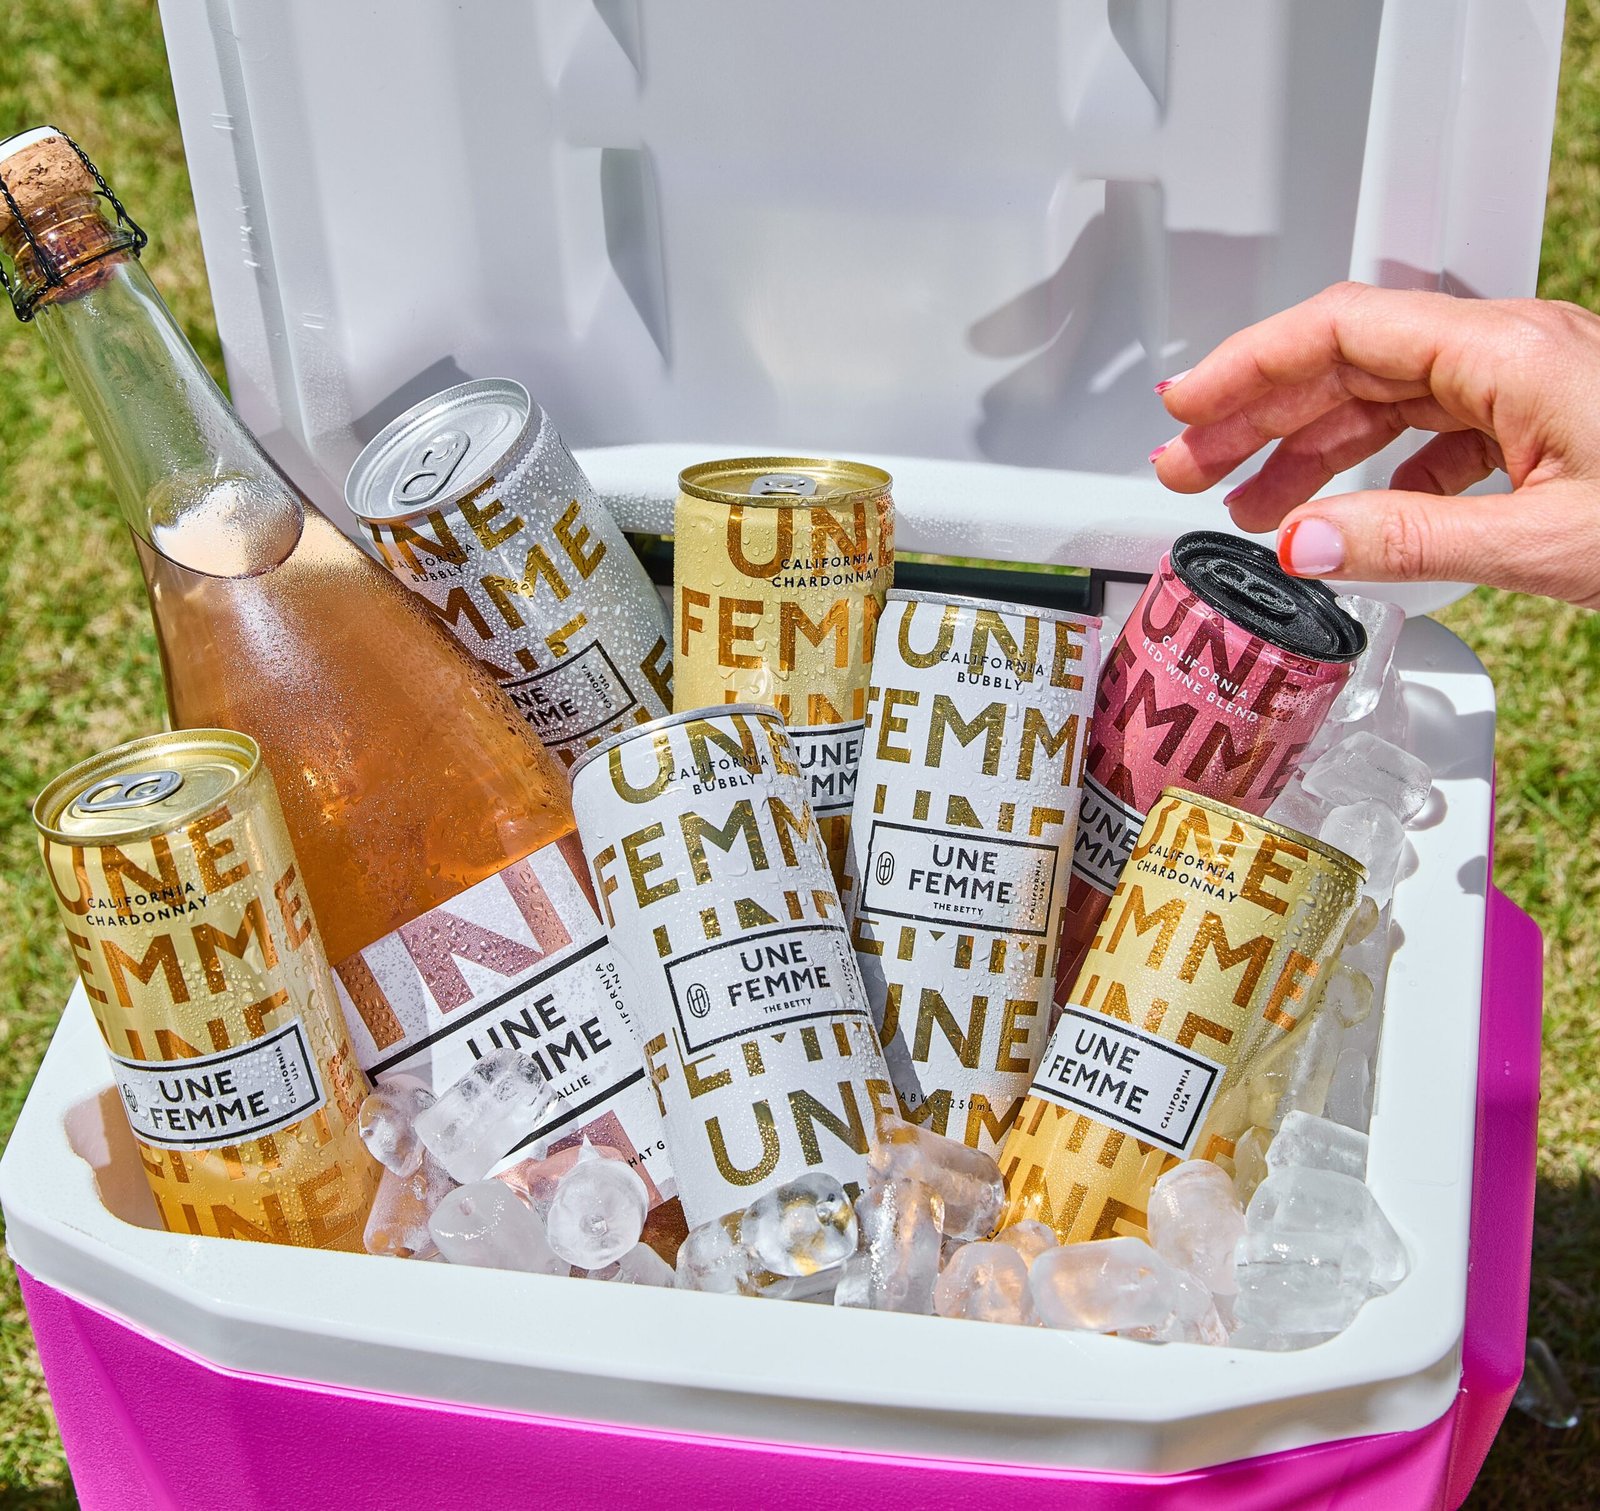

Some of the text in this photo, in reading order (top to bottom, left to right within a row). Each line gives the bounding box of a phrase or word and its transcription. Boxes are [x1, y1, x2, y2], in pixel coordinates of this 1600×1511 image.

[389, 543, 475, 570] CALIFORNIA
[411, 500, 607, 641] MME
[411, 563, 464, 583] BUBBLY
[780, 552, 874, 571] CALIFORNIA
[772, 568, 879, 589] CHARDONNAY
[681, 585, 881, 672] FEM
[898, 602, 1087, 691] UNE
[1141, 572, 1319, 724] UNE
[939, 650, 1045, 677] CALIFORNIA
[957, 671, 1024, 692] BUBBLY
[1142, 637, 1259, 724] RED WINE BLEND
[1162, 635, 1249, 701] CALIFORNIA
[509, 687, 549, 709] NE
[1094, 634, 1311, 800] EMME
[796, 739, 859, 770] UNE
[865, 687, 1094, 789] EMM
[607, 712, 798, 805] UNE
[667, 756, 769, 783] CALIFORNIA
[692, 773, 756, 795] BUBBLY
[1079, 796, 1139, 854] UNE
[42, 806, 250, 917] UNE
[593, 797, 827, 930] FEMM
[932, 844, 999, 876] UNE
[1132, 798, 1308, 917] UNE
[1149, 842, 1236, 884] CALIFORNIA
[87, 882, 196, 910] CALIFORNIA
[908, 867, 1013, 905] FEMME
[1029, 859, 1042, 921] CALIFORNIA
[1136, 859, 1240, 905] CHARDONNAY
[86, 896, 208, 928] CHARDONNAY
[933, 901, 985, 917] THE BETTY
[66, 862, 313, 1009] EMME
[739, 940, 808, 974] UNE
[727, 965, 830, 1007] FEMME
[763, 997, 812, 1014] THE BETTY
[289, 1060, 299, 1080] USA
[1074, 1029, 1141, 1075] UNE
[158, 1069, 239, 1103] UNE
[275, 1046, 297, 1104] CALIFORNIA
[557, 1074, 591, 1102] ALLIE
[1047, 1055, 1149, 1115] FEMME
[151, 1090, 271, 1133] FEMME
[900, 1092, 927, 1104] ABV
[1161, 1068, 1192, 1130] CALIFORNIA
[1177, 1092, 1192, 1114] USA
[627, 1146, 653, 1168] HAT
